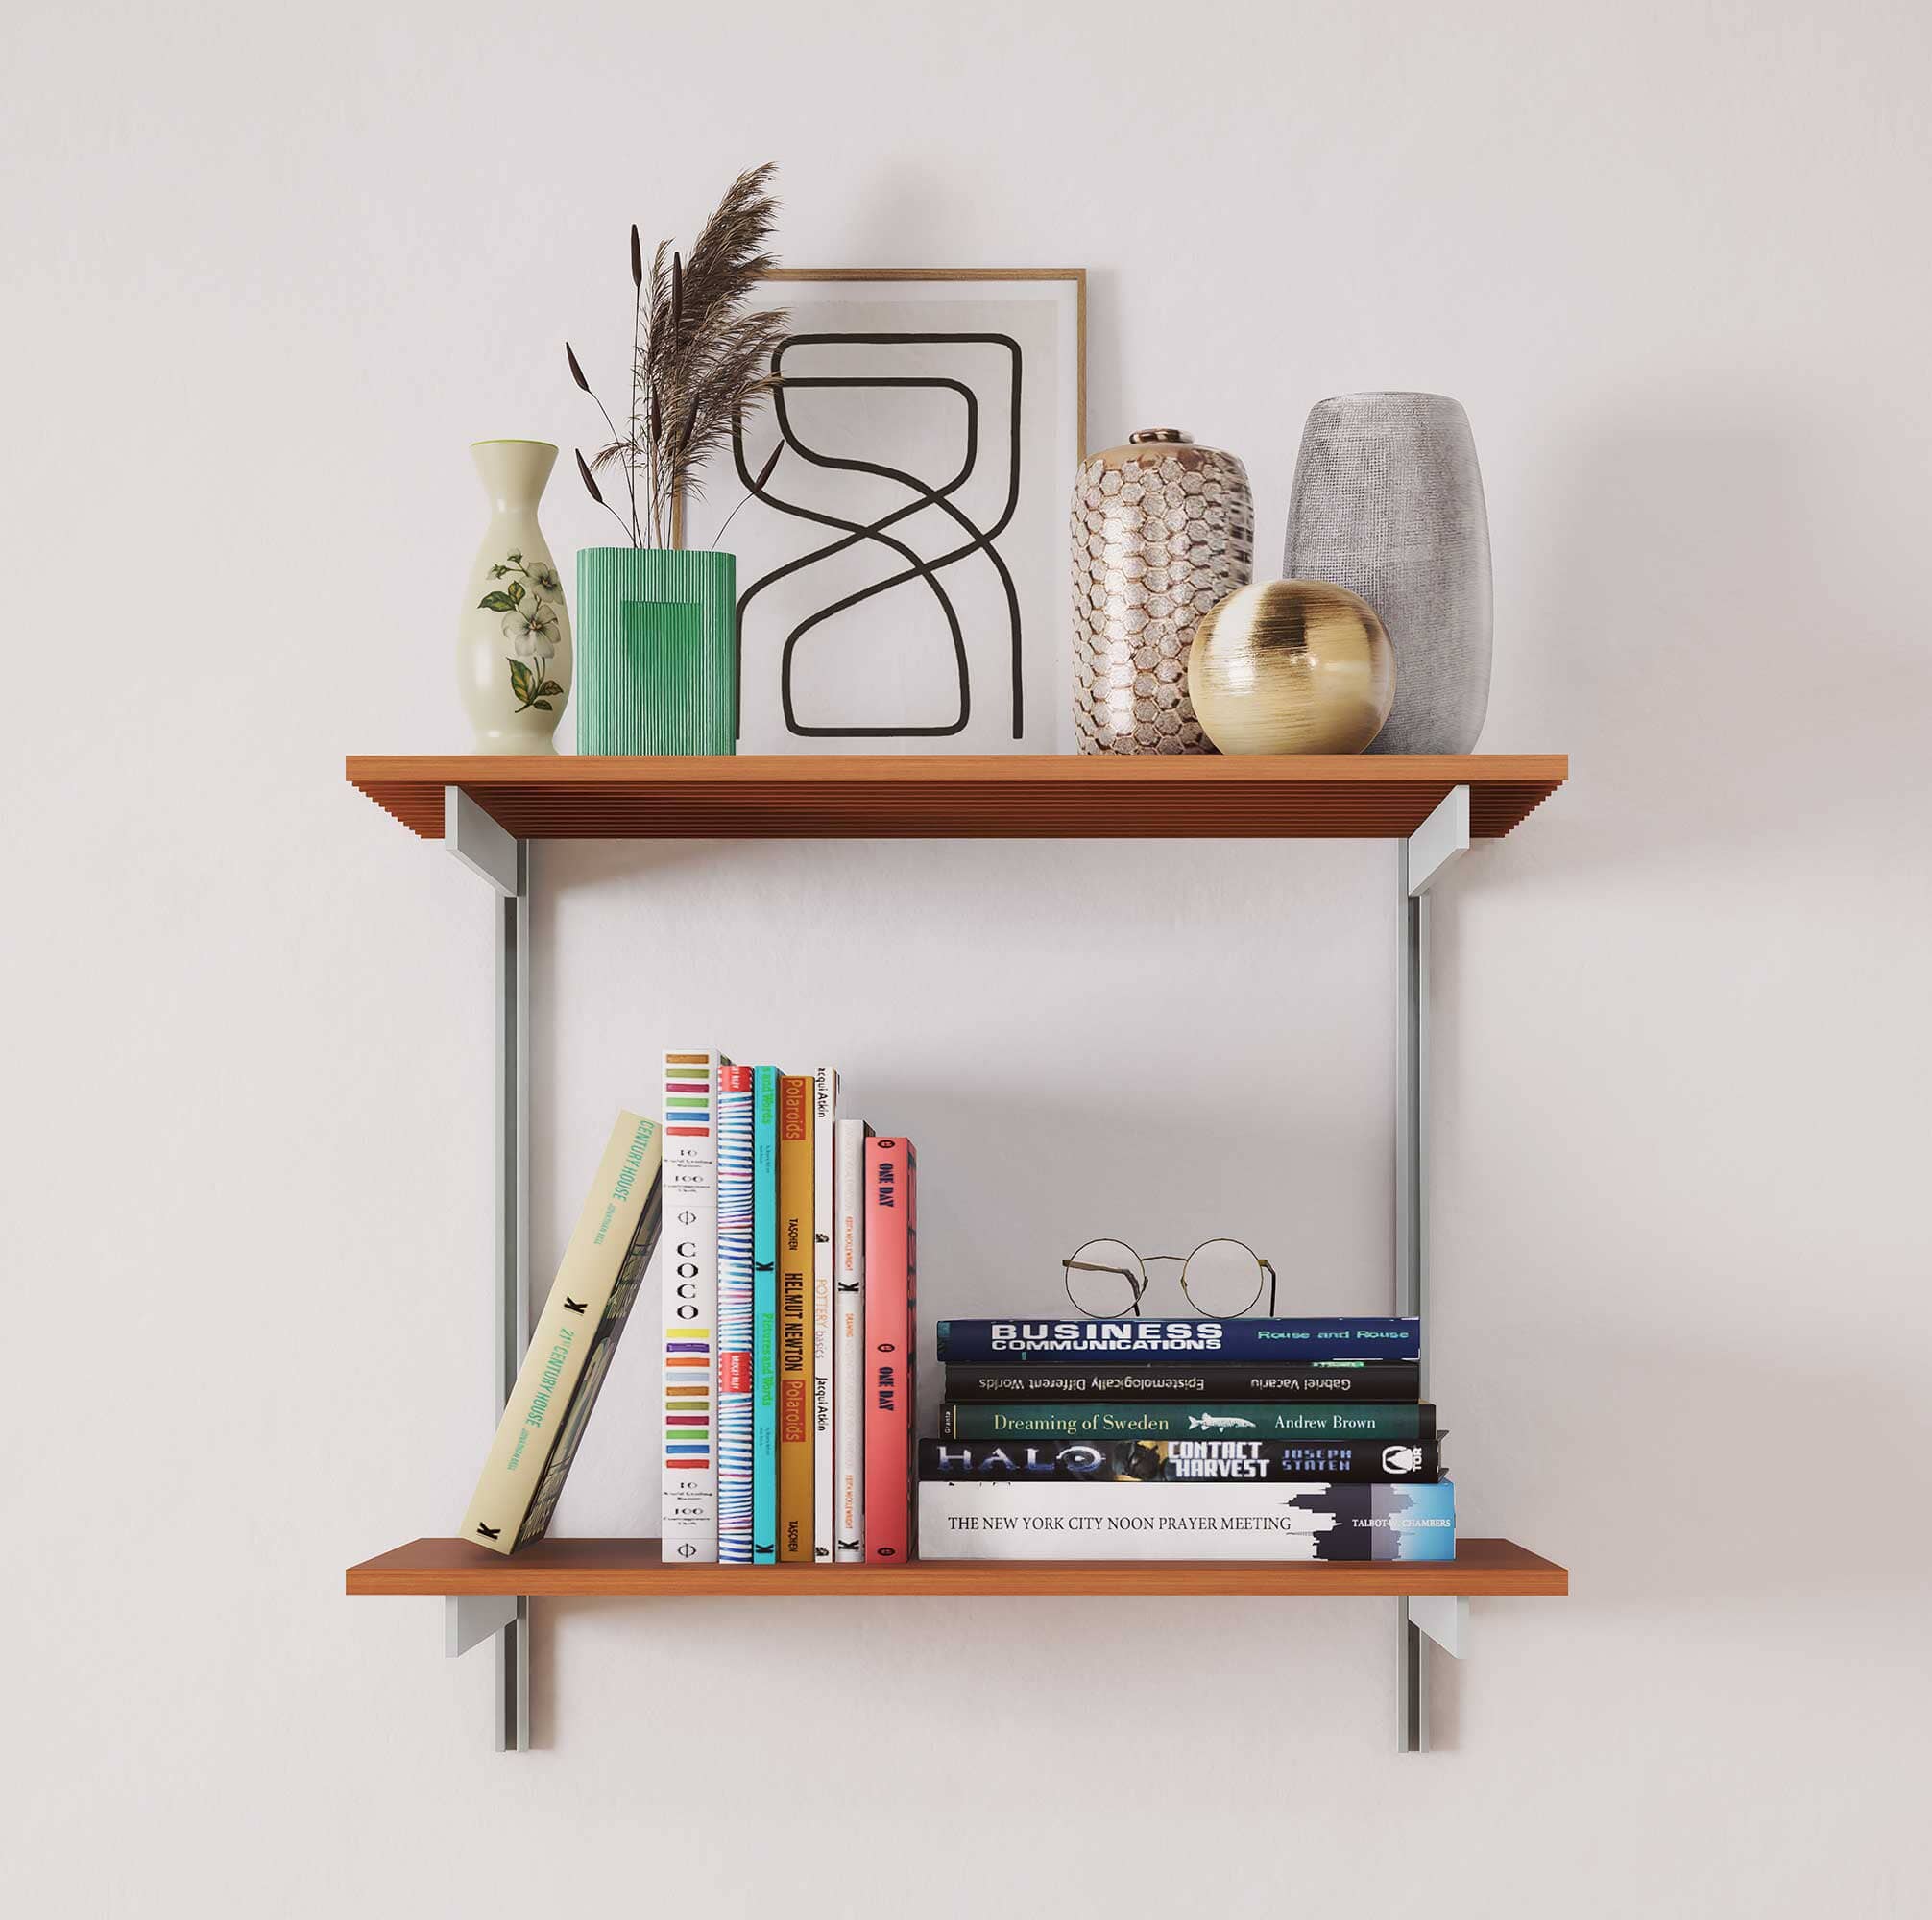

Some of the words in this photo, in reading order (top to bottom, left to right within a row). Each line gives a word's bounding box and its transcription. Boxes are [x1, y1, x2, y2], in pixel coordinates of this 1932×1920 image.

[761, 1075, 774, 1092] and
[761, 1094, 775, 1124] Words
[786, 1079, 803, 1140] Polaroids
[817, 1092, 829, 1117] Atkin
[627, 1120, 655, 1168] CENTURY
[613, 1165, 638, 1202] HOUSE
[879, 1163, 894, 1184] ONE
[879, 1187, 894, 1208] DAY
[789, 1218, 798, 1250] TASCHEN
[677, 1241, 699, 1320] COCO
[785, 1273, 803, 1326] HELMUT
[816, 1279, 829, 1328] POTTERY
[761, 1313, 775, 1354] Pictures
[991, 1323, 1223, 1340] BUSINESS
[1258, 1331, 1310, 1340] Rouse
[1317, 1331, 1350, 1339] and
[1357, 1330, 1409, 1339] Rouse
[785, 1328, 803, 1372] NEWTON
[815, 1331, 826, 1358] basics
[991, 1339, 1221, 1351] COMMUNICATIONS
[539, 1346, 568, 1396] CENTURY
[761, 1356, 774, 1374] and
[879, 1367, 894, 1387] ONE
[979, 1378, 1024, 1390] Worlds
[1029, 1378, 1086, 1390] Different
[1091, 1376, 1204, 1390] Epistemologically
[1251, 1378, 1300, 1390] Vacariu
[1304, 1378, 1351, 1391] Gabriel
[761, 1376, 775, 1406] Words
[815, 1377, 828, 1404] Jacqui
[879, 1390, 894, 1411] DAY
[526, 1392, 549, 1428] HOUSE
[786, 1380, 803, 1442] Polaroids
[817, 1405, 829, 1431] Atkin
[994, 1414, 1077, 1434] Dreaming
[1082, 1414, 1099, 1430] of
[1103, 1414, 1169, 1430] Sweden
[1275, 1415, 1327, 1428] Andrew
[1333, 1415, 1376, 1428] Brown
[937, 1445, 1106, 1472] HALO
[1167, 1441, 1263, 1459] CONTACT
[1282, 1449, 1352, 1459] JOSEPH
[1413, 1447, 1423, 1471] TOR
[1169, 1459, 1269, 1477] HARVEST
[1282, 1459, 1351, 1471] STATEN
[948, 1517, 979, 1530] THE
[982, 1517, 1019, 1530] NEW
[1023, 1517, 1065, 1530] YORK
[1068, 1517, 1104, 1530] CITY
[1108, 1517, 1154, 1530] NOON
[1158, 1517, 1218, 1530] PRAYER
[1220, 1517, 1292, 1530] MEETING
[1352, 1519, 1388, 1527] TALBOT
[1403, 1519, 1451, 1527] CHAMBERS
[789, 1520, 798, 1552] TASCHEN
